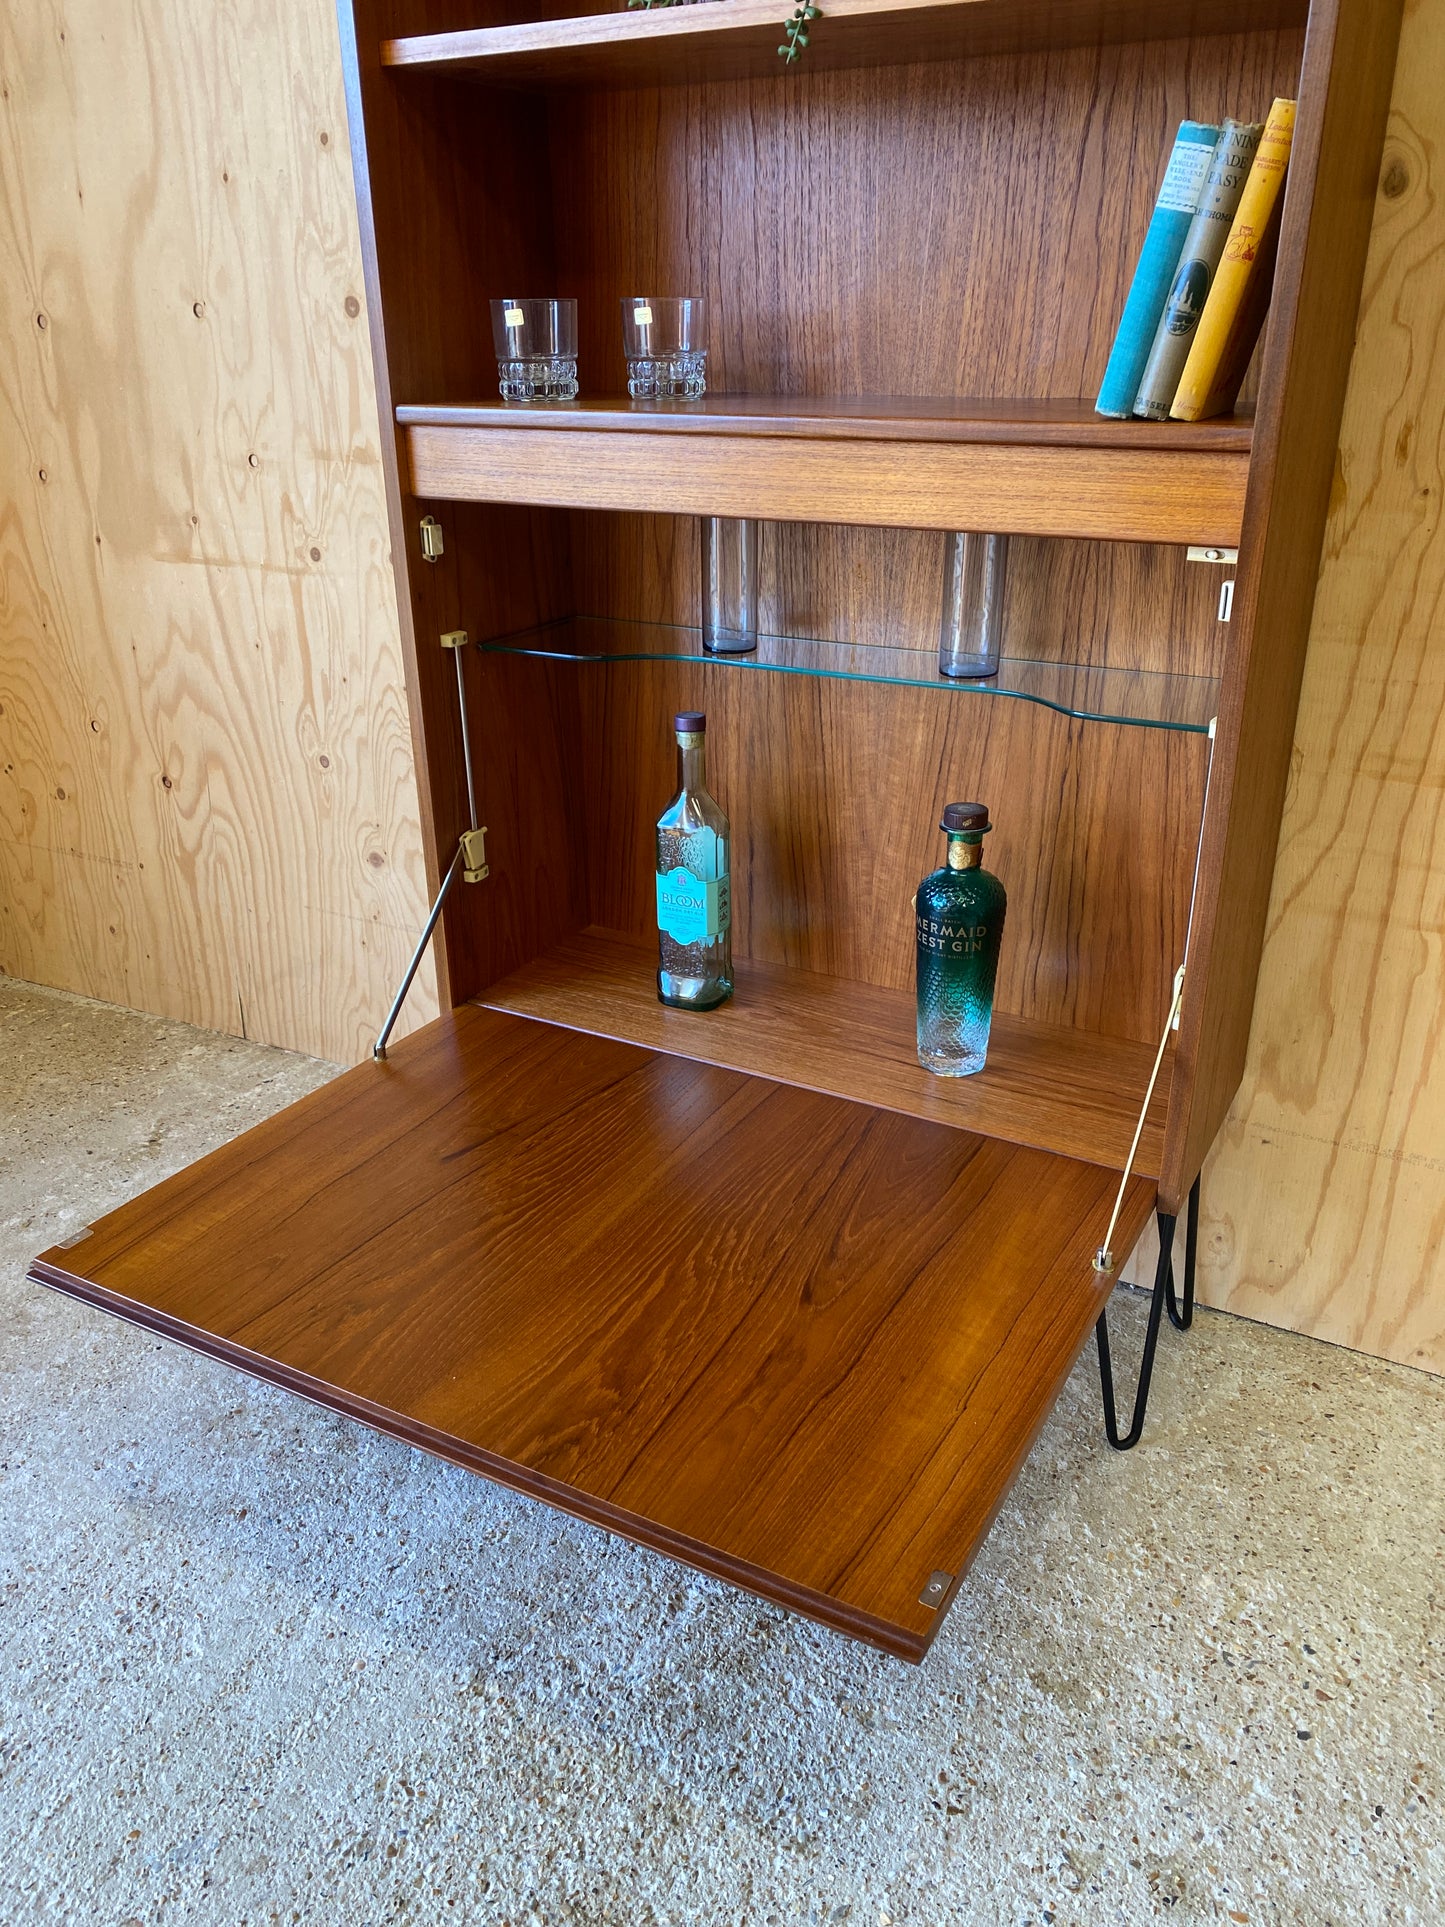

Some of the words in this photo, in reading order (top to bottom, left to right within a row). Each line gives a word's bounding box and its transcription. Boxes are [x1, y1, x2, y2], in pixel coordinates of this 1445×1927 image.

[1213, 151, 1248, 169] MADE
[1208, 171, 1242, 188] EASY
[1136, 397, 1170, 411] CASSEL
[662, 893, 704, 909] BLOOM
[917, 930, 946, 950] ZEST
[952, 941, 982, 953] GIN
